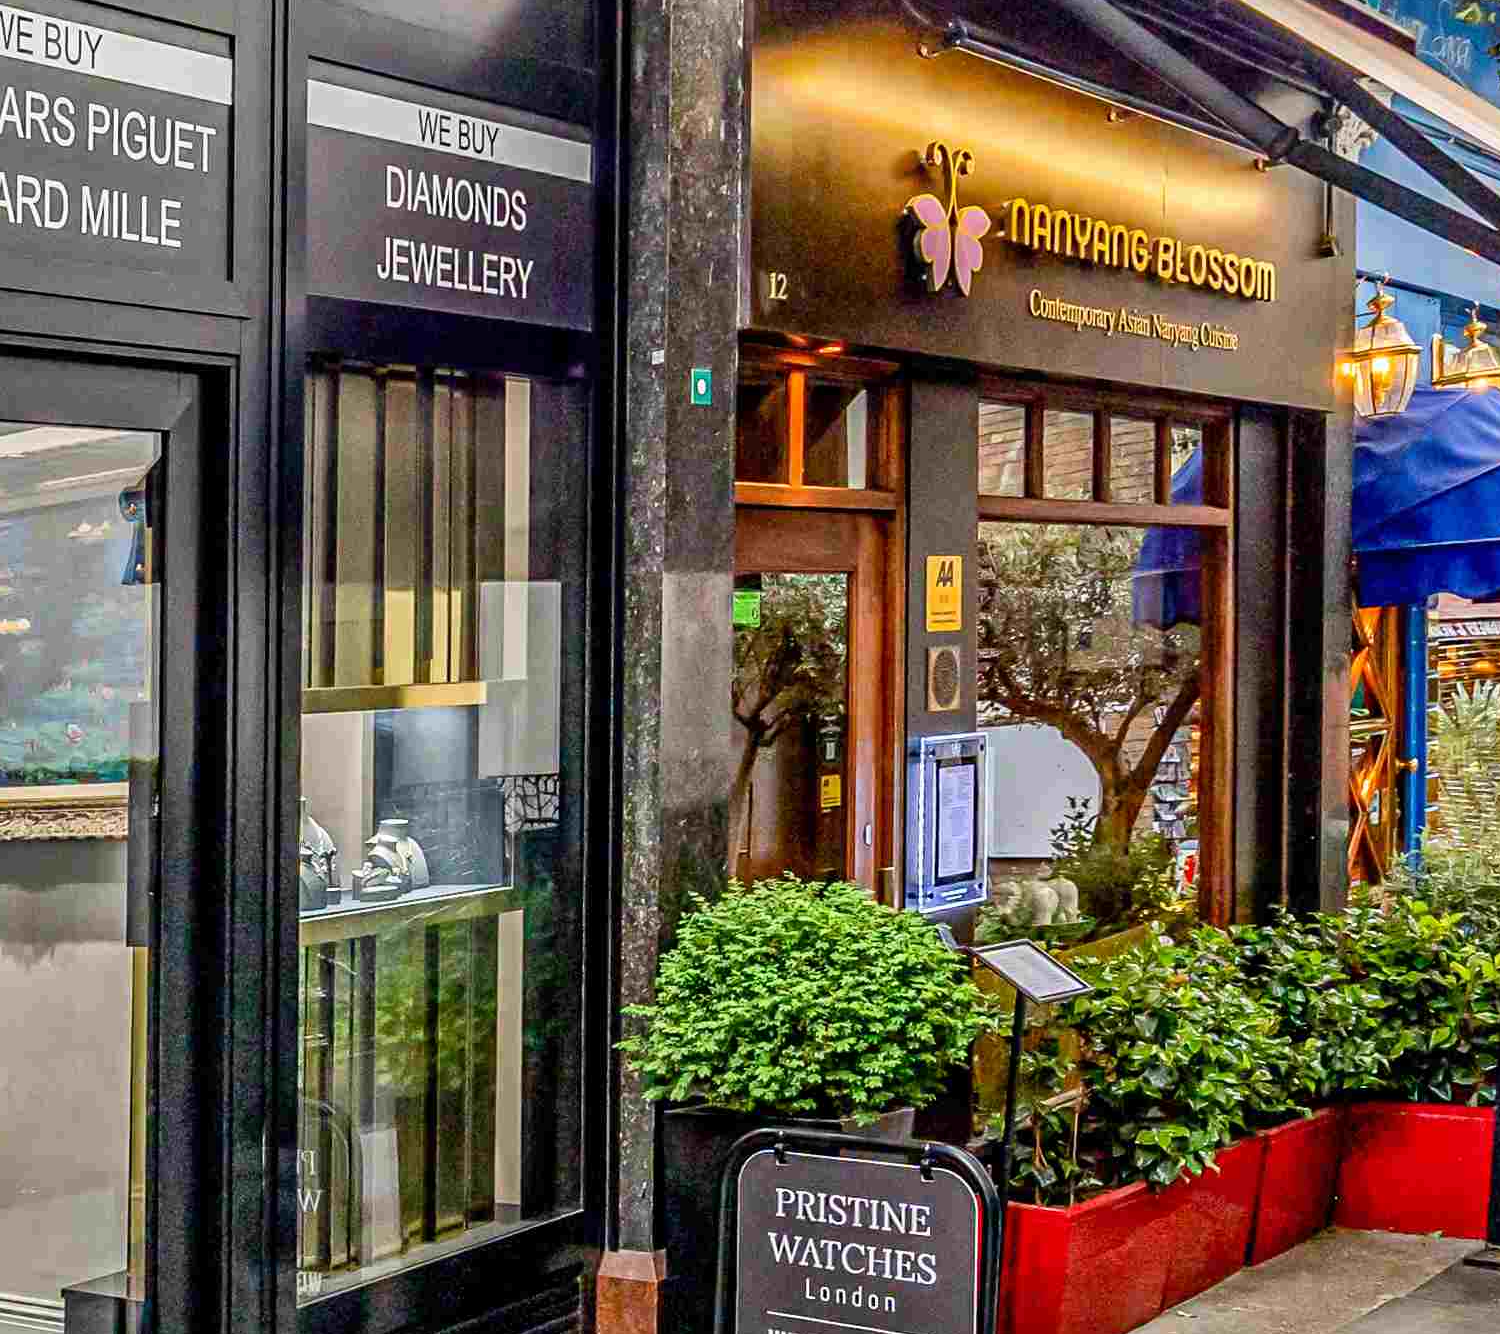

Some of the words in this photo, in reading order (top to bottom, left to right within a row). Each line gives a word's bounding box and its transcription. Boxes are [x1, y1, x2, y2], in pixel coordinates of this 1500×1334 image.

[44, 21, 104, 70] BUY
[87, 102, 218, 173] PIGUET
[418, 108, 452, 148] WE
[458, 118, 500, 158] BUY
[80, 184, 183, 249] MILLE
[386, 164, 528, 232] DIAMONDS
[377, 236, 534, 300] JEWELLERY
[1010, 197, 1151, 273] NANYANG
[1155, 236, 1277, 303] BLOSSOM
[768, 270, 789, 301] 12
[1029, 288, 1116, 336] Contemporary
[1118, 308, 1151, 337] Asian
[1152, 313, 1200, 352] Nanyang
[776, 1188, 932, 1237] PRISTINE
[768, 1232, 937, 1284] WATCHES
[805, 1278, 897, 1313] London
